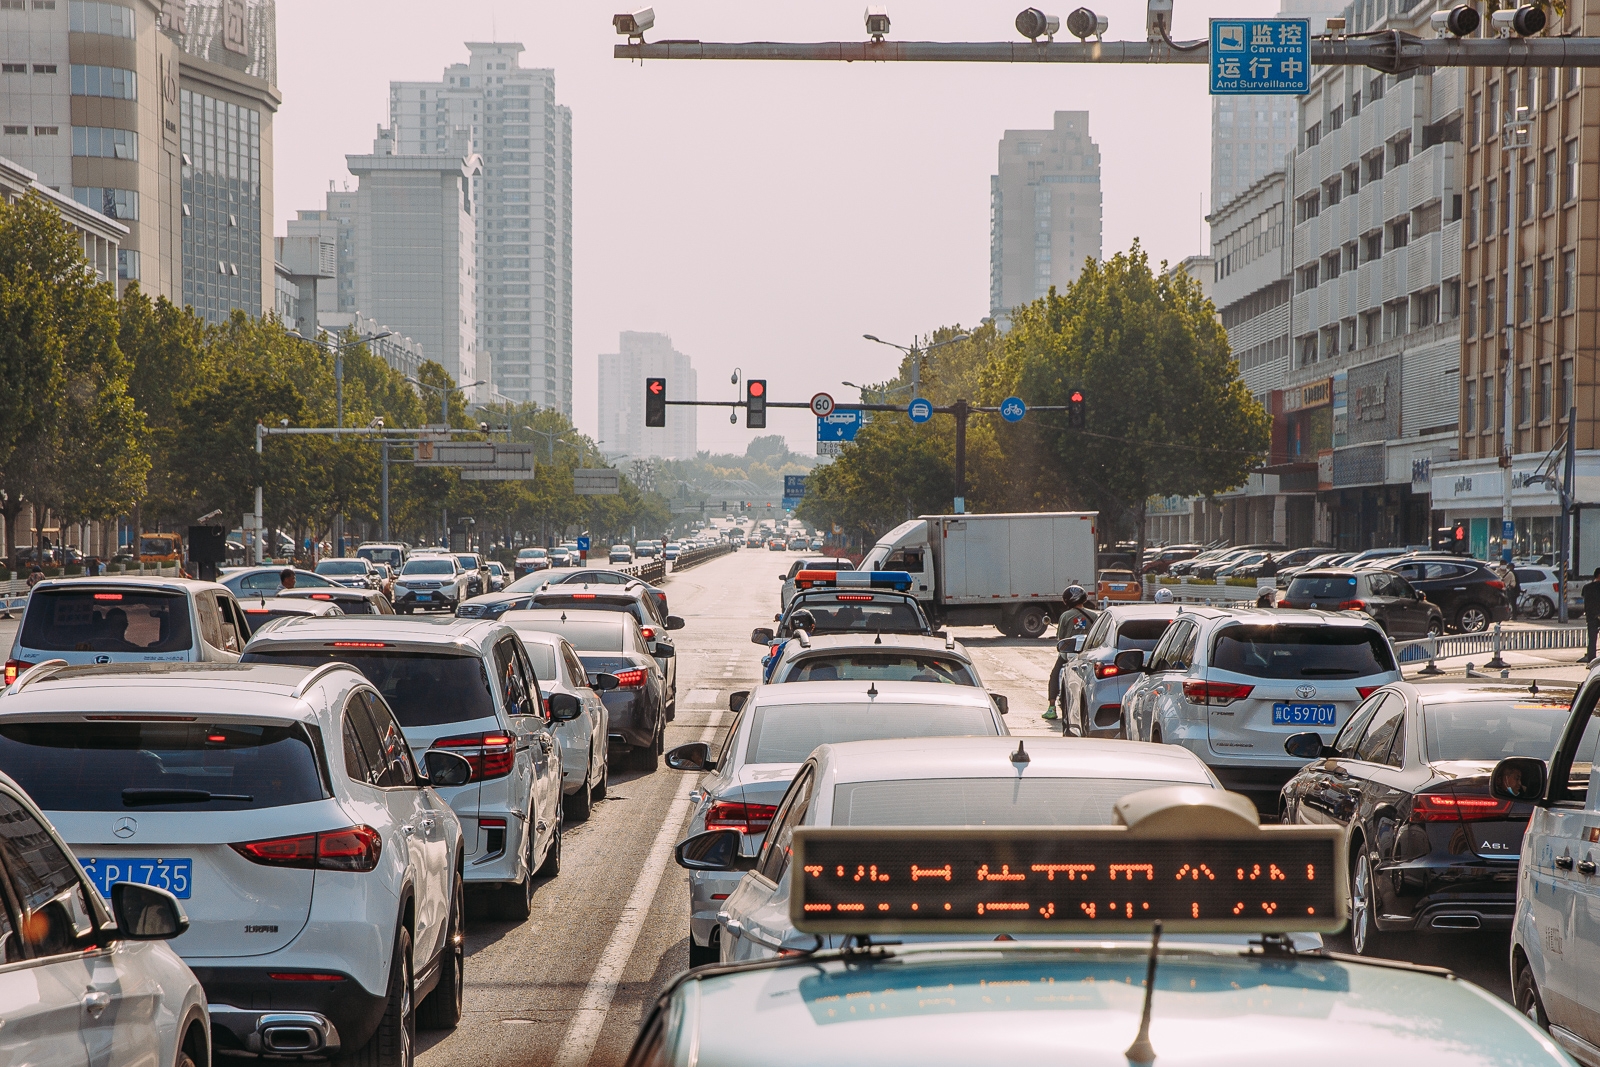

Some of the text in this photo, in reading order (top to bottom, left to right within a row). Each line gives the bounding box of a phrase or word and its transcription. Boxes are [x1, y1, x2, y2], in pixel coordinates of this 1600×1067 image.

[1250, 24, 1302, 45] 监控
[1250, 45, 1302, 53] Cameras
[1217, 57, 1303, 79] 运行中
[1216, 80, 1303, 88] And Surveillance
[815, 399, 829, 410] 60
